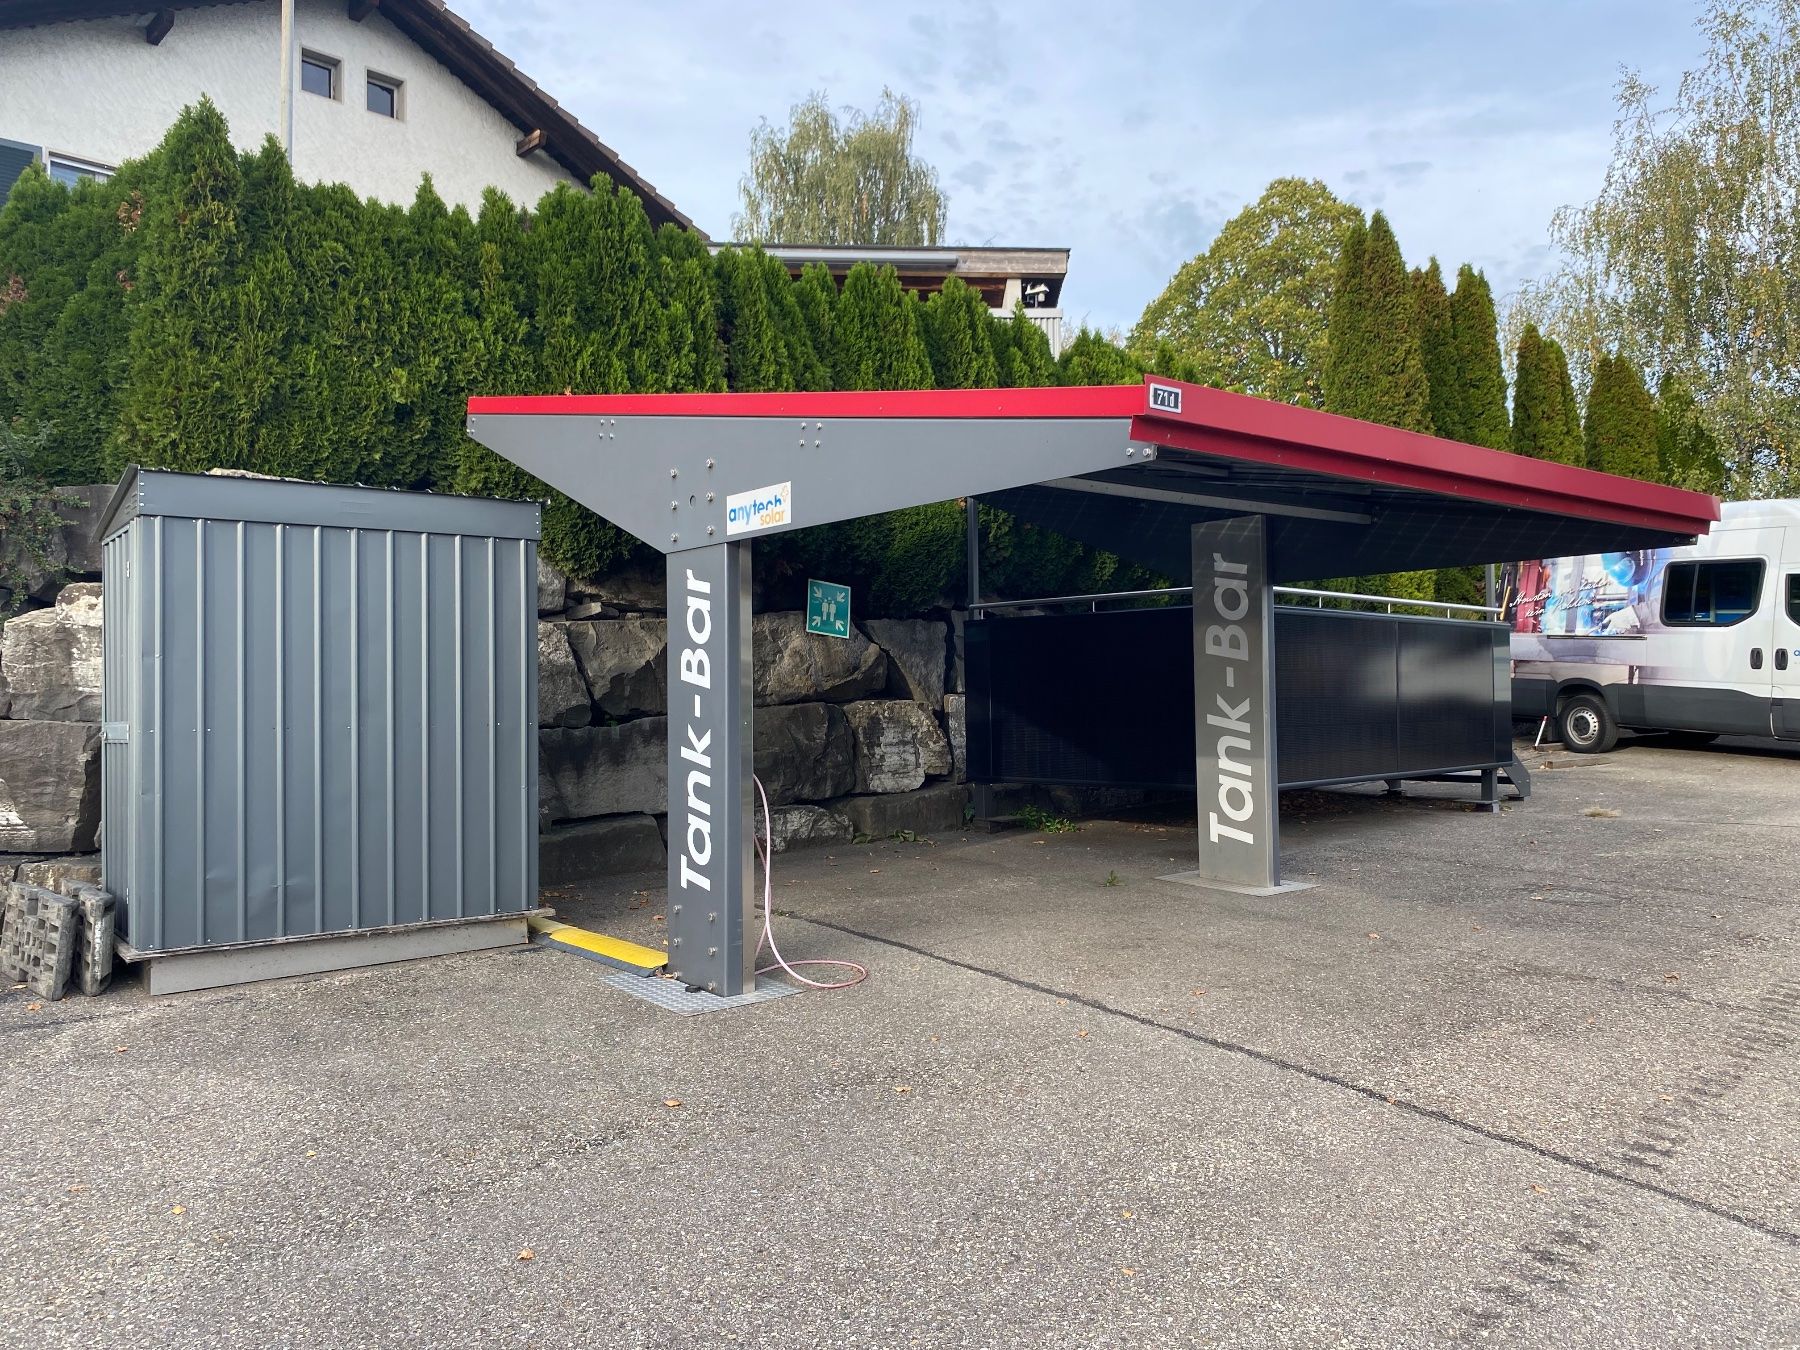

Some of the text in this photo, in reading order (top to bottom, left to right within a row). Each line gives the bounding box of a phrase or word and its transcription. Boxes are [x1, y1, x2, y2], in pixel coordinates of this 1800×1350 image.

[1157, 390, 1175, 407] 71d
[760, 507, 785, 526] solar
[680, 568, 712, 892] Tank-Bar
[1205, 552, 1254, 845] Tank-Bar
